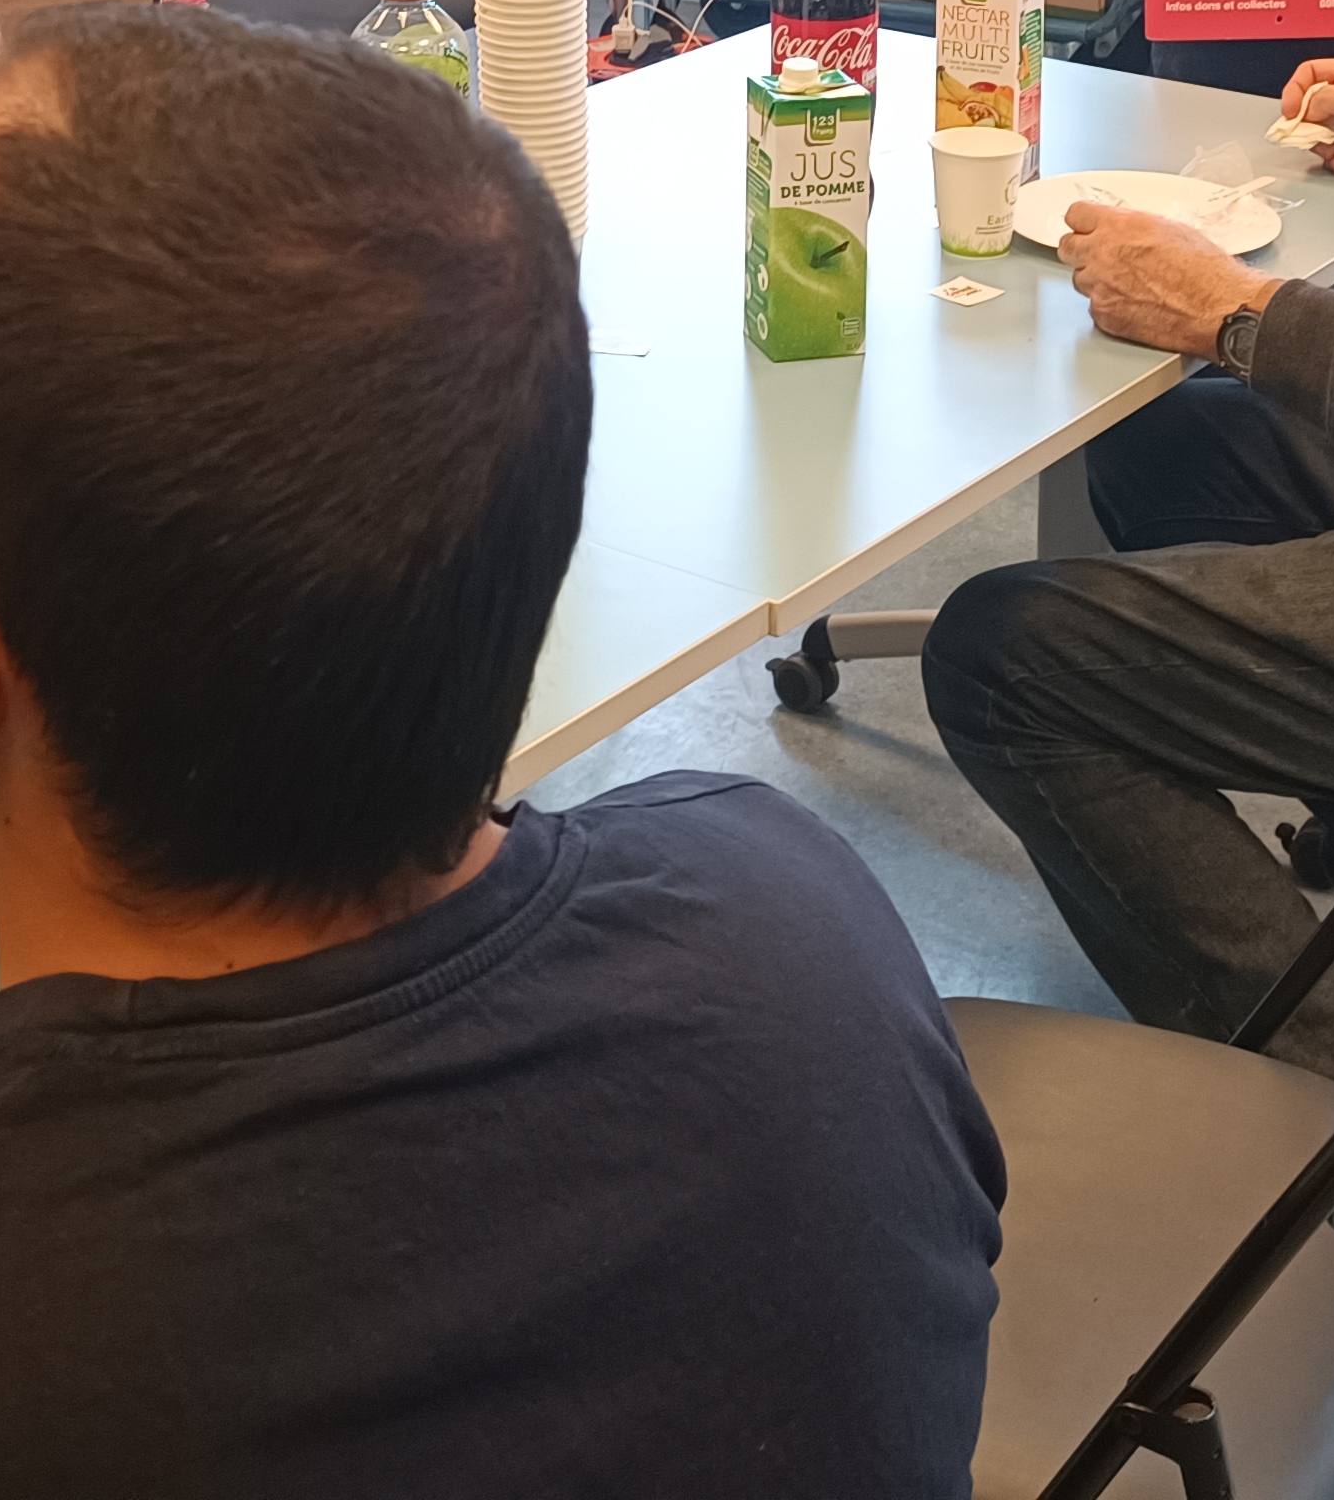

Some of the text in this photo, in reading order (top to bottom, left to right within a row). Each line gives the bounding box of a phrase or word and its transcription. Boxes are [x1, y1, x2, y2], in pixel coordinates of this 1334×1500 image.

[942, 5, 1010, 26] NECTAR
[1166, 1, 1192, 12] Infos
[1195, 0, 1221, 11] dons
[1224, 0, 1234, 10] et
[1237, 0, 1286, 10] collectes
[942, 22, 1010, 45] MULTI
[772, 22, 875, 70] Coca-Cola
[941, 40, 1010, 63] FRUITS
[812, 115, 834, 127] 123
[791, 150, 856, 181] JUS
[781, 181, 865, 199] DE POMME
